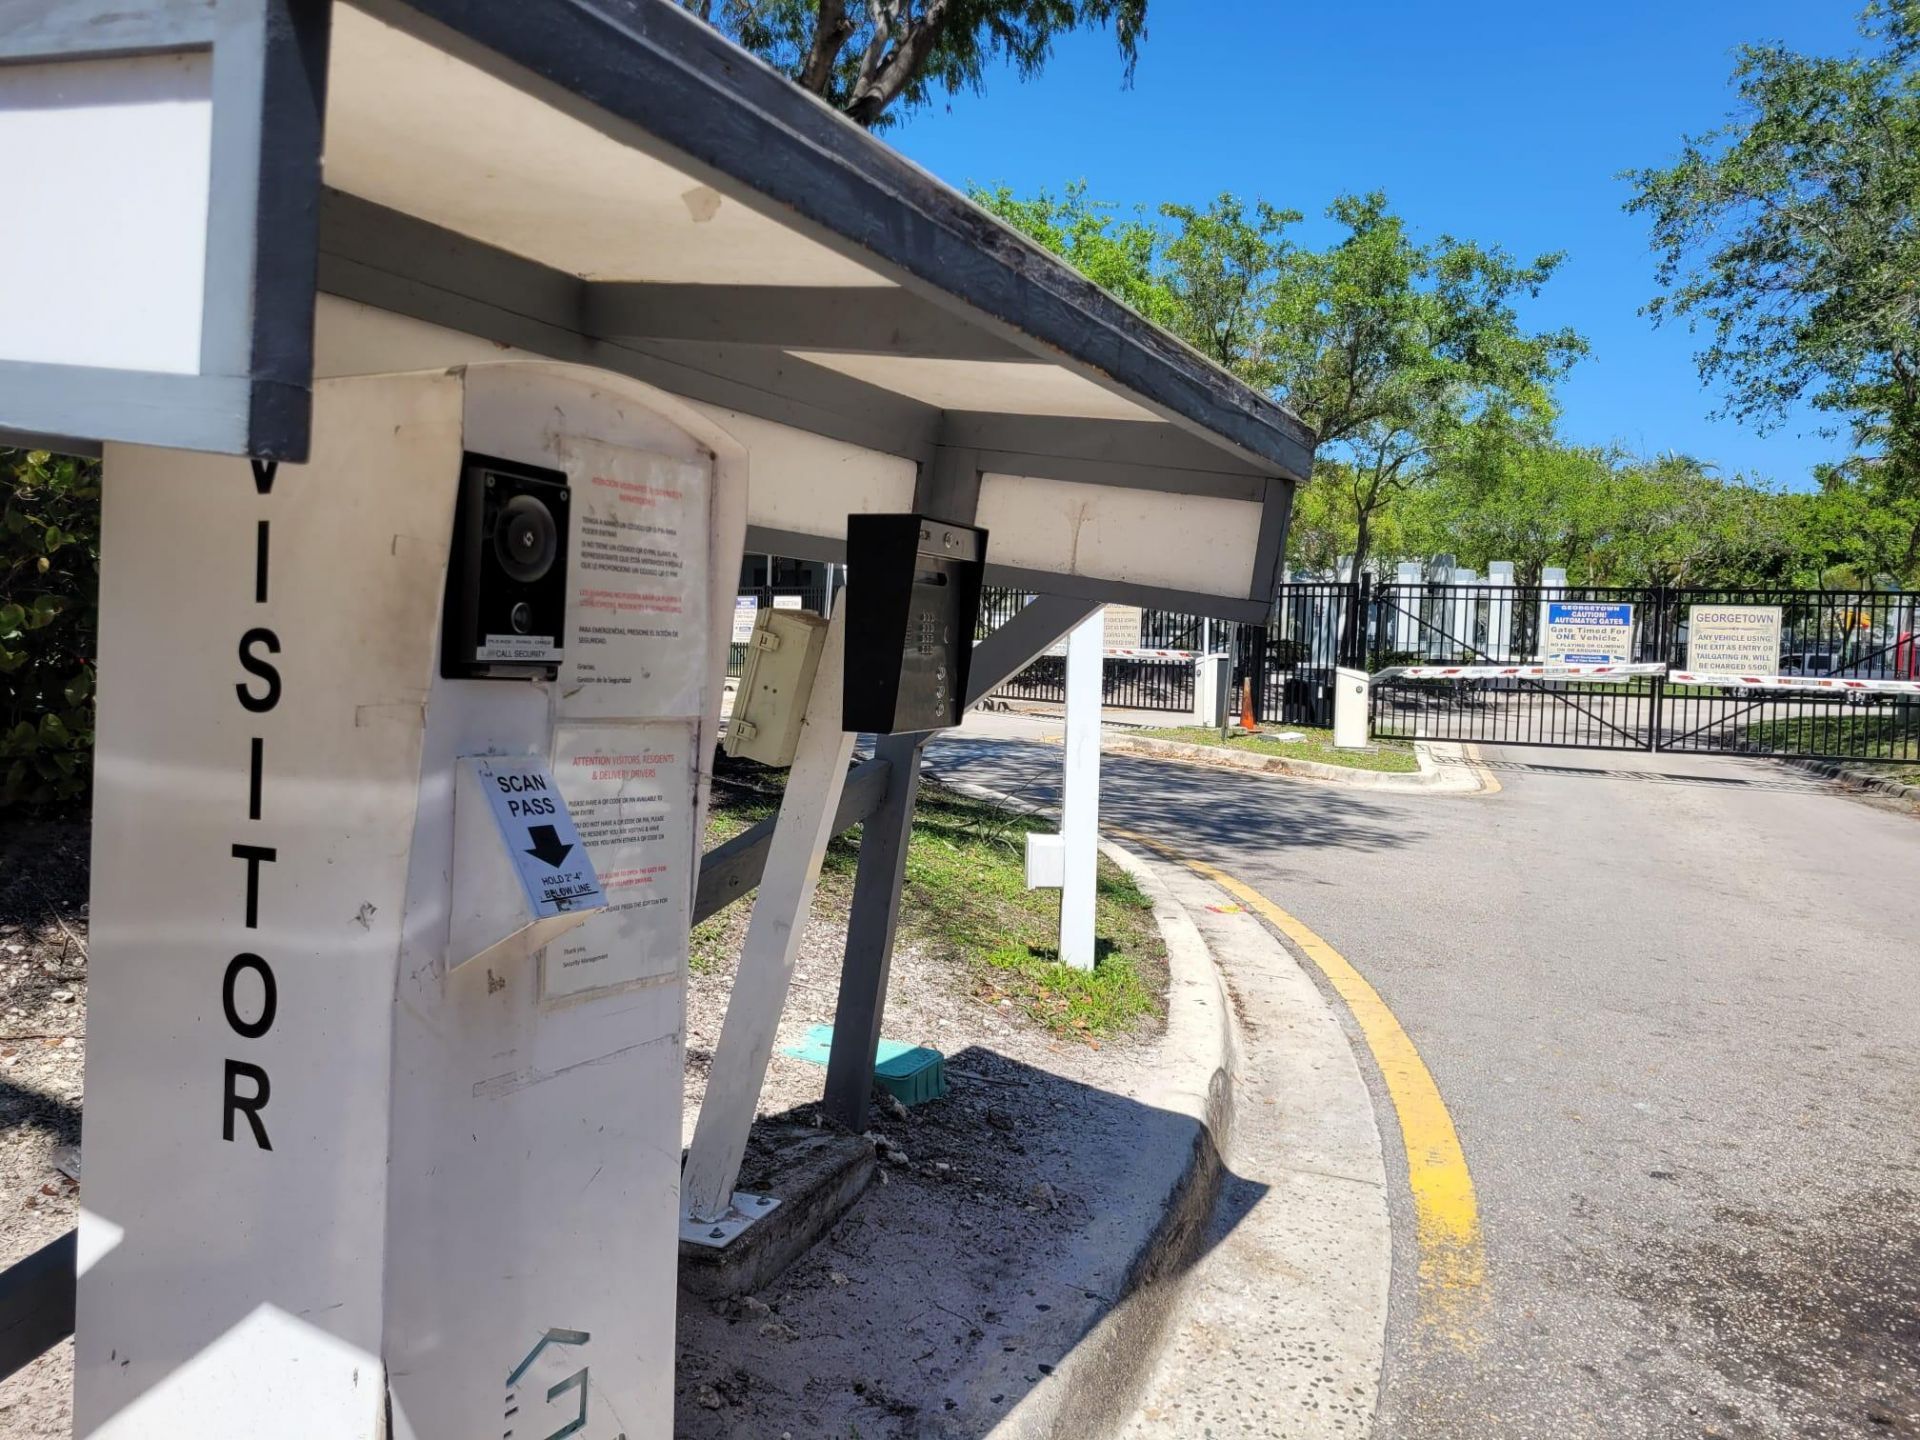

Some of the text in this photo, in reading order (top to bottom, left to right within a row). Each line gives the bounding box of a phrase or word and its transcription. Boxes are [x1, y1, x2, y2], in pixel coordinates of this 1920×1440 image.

[1696, 613, 1774, 623] GEORGETOWN
[1556, 633, 1576, 641] ONE
[496, 650, 546, 658] CALL SECURITY
[573, 756, 610, 766] ATTENTION
[643, 754, 674, 764] RESIDENTS
[599, 770, 630, 780] DELIVERY
[630, 769, 656, 779] DRIVERS
[496, 773, 547, 794] SCAN
[506, 797, 556, 818] PASS
[541, 875, 564, 886] HOLD
[543, 887, 574, 898] BELOW
[575, 883, 593, 894] LINE
